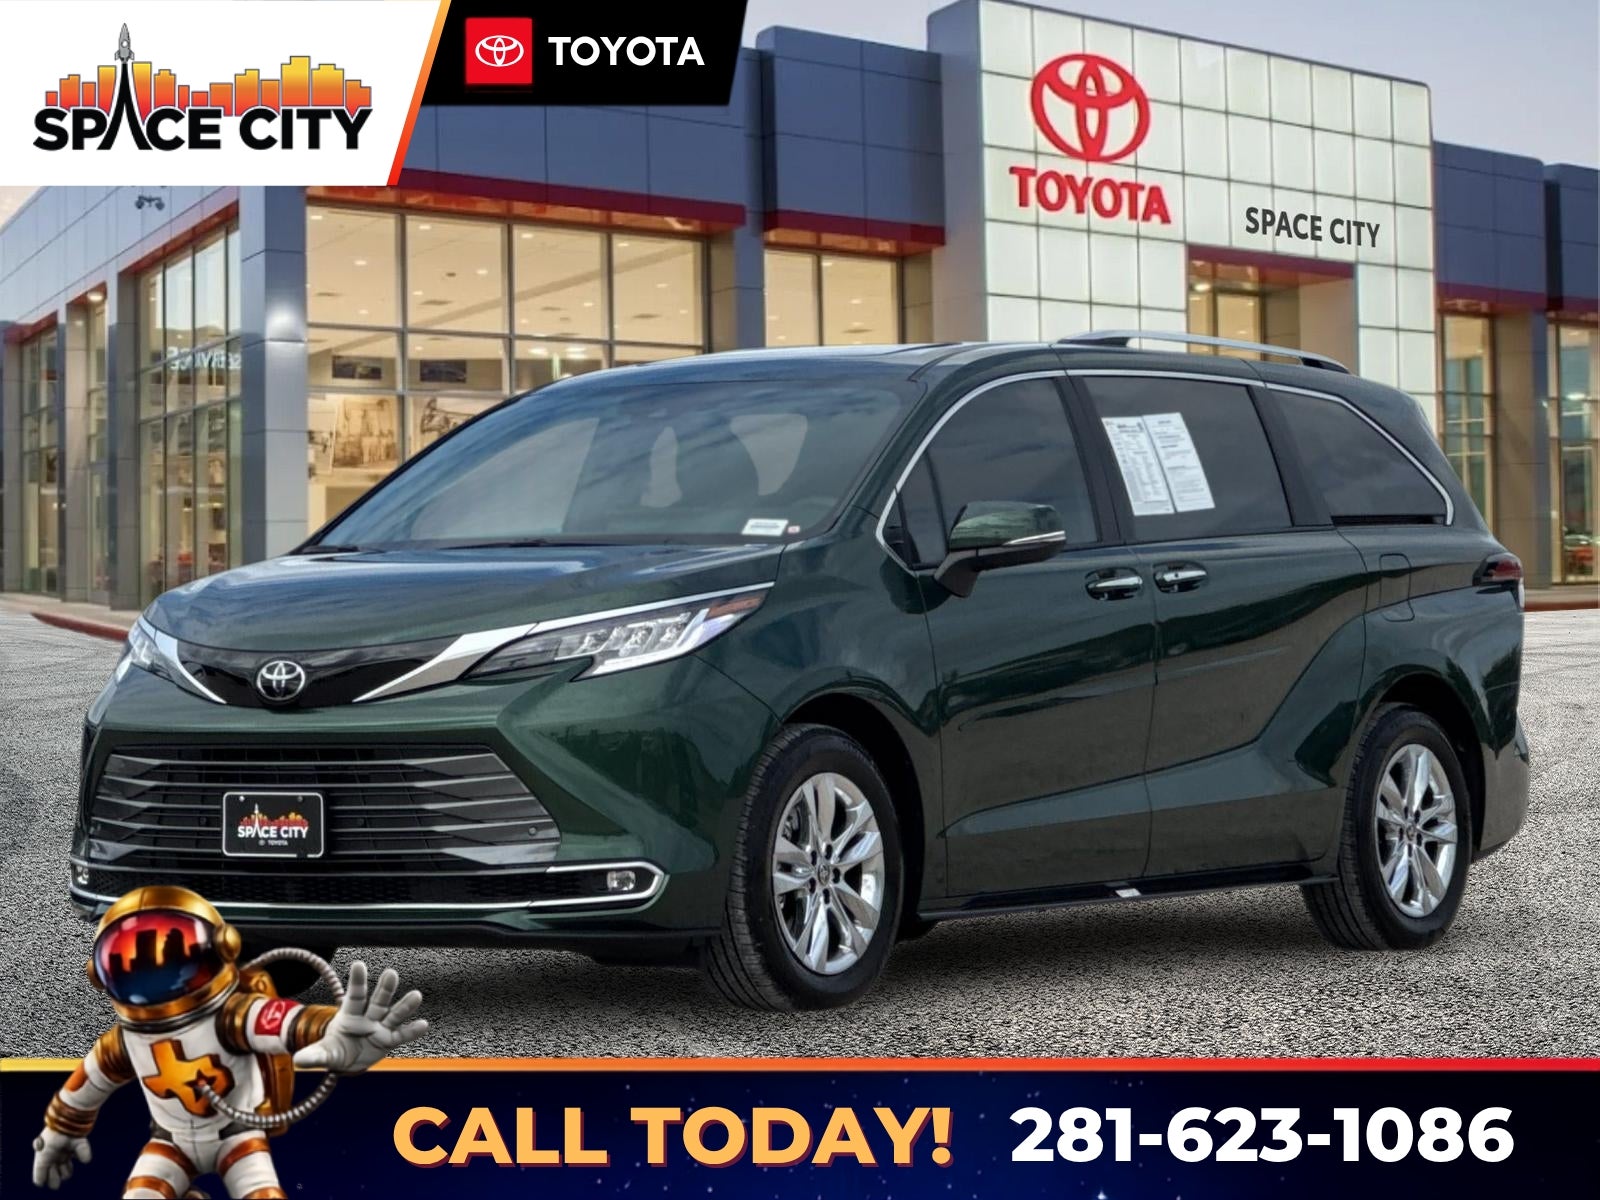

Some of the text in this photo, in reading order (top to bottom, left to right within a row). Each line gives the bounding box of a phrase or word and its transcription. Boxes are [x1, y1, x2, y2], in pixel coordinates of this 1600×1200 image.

[1009, 165, 1171, 225] TOYOTA
[1244, 205, 1382, 249] SPACE CITY
[237, 825, 309, 839] SPACE CITY
